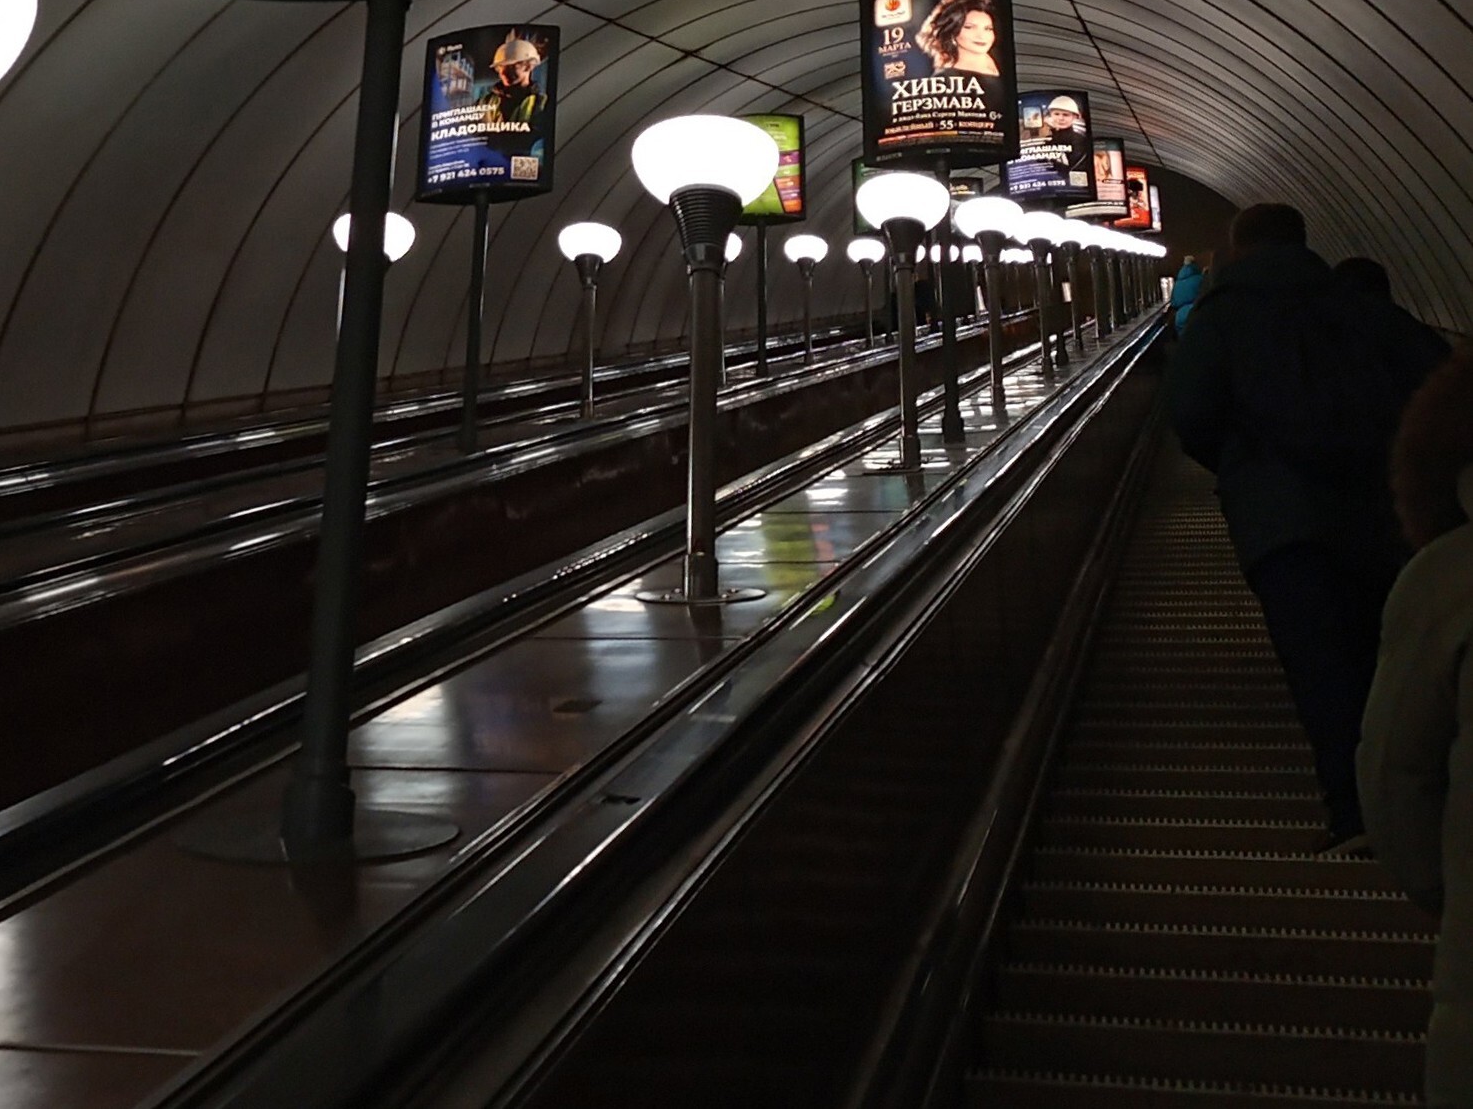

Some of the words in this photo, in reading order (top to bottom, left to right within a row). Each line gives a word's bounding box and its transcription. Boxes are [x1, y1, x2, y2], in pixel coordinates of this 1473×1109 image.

[883, 27, 905, 45] 19
[878, 41, 912, 54] МАРТА
[892, 76, 985, 100] ХИБЛА
[432, 104, 497, 121] ПРИГЛАШАЕМ
[892, 96, 986, 115] ГЕРЗМАВА
[439, 113, 485, 127] КОМАНДУ
[939, 120, 954, 130] 55
[431, 121, 531, 142] КЛАДОВЩИКА
[457, 168, 477, 178] 424
[479, 167, 505, 176] 0575
